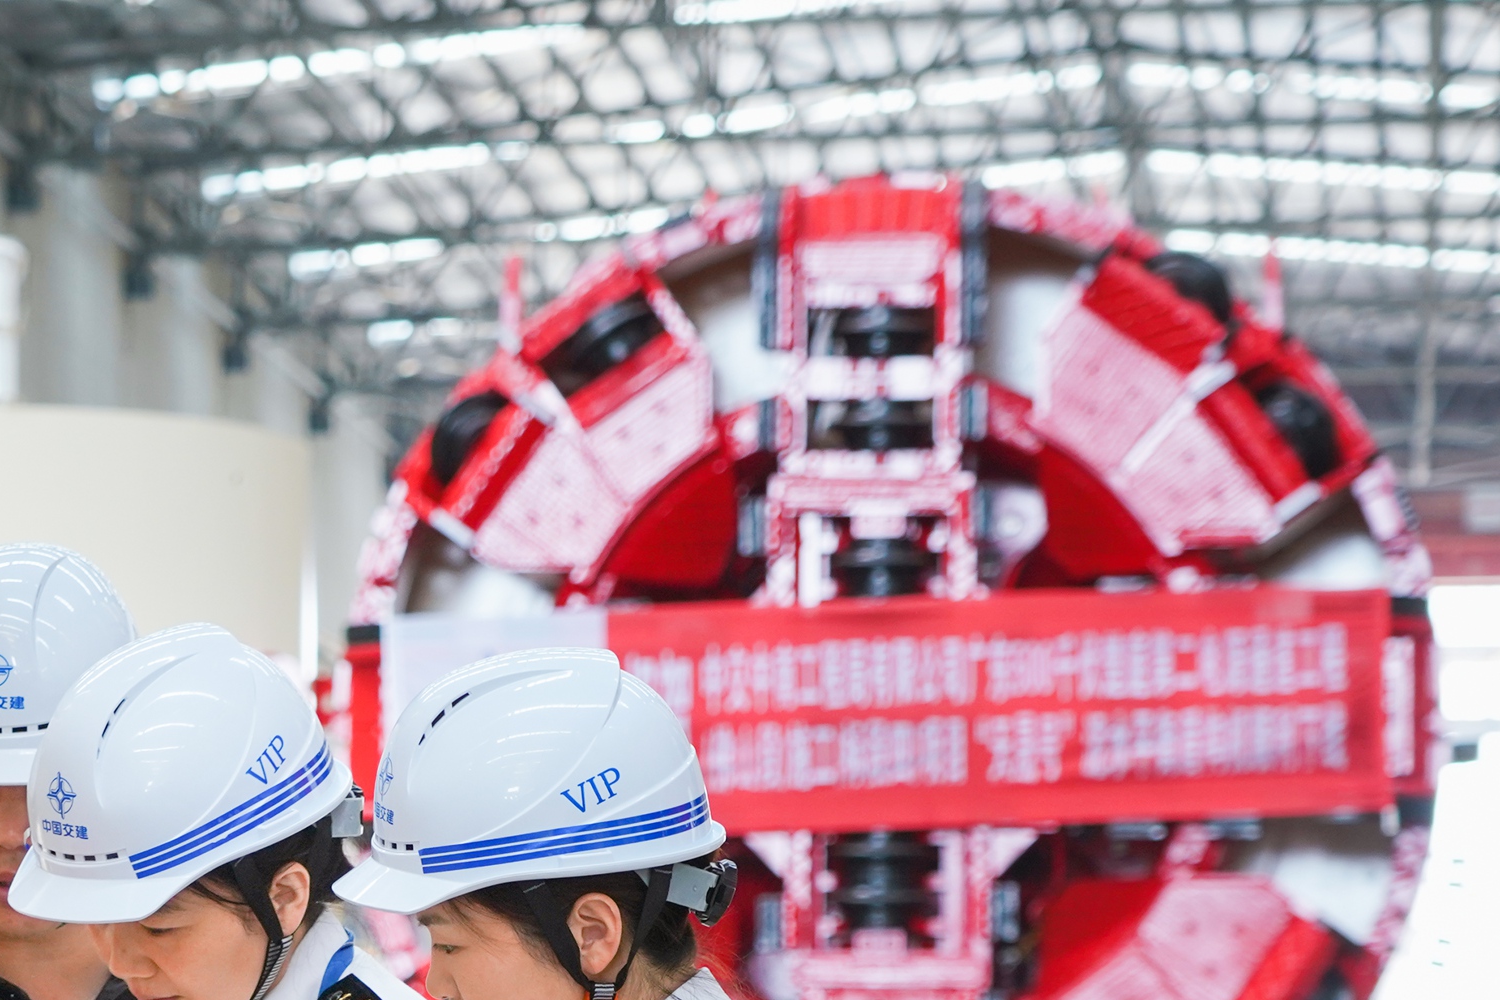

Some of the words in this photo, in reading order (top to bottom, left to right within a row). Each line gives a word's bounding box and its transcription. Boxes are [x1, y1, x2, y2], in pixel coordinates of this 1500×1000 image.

[245, 734, 287, 785] VIP
[560, 767, 620, 813] VIP
[41, 819, 89, 840] 中国交建
